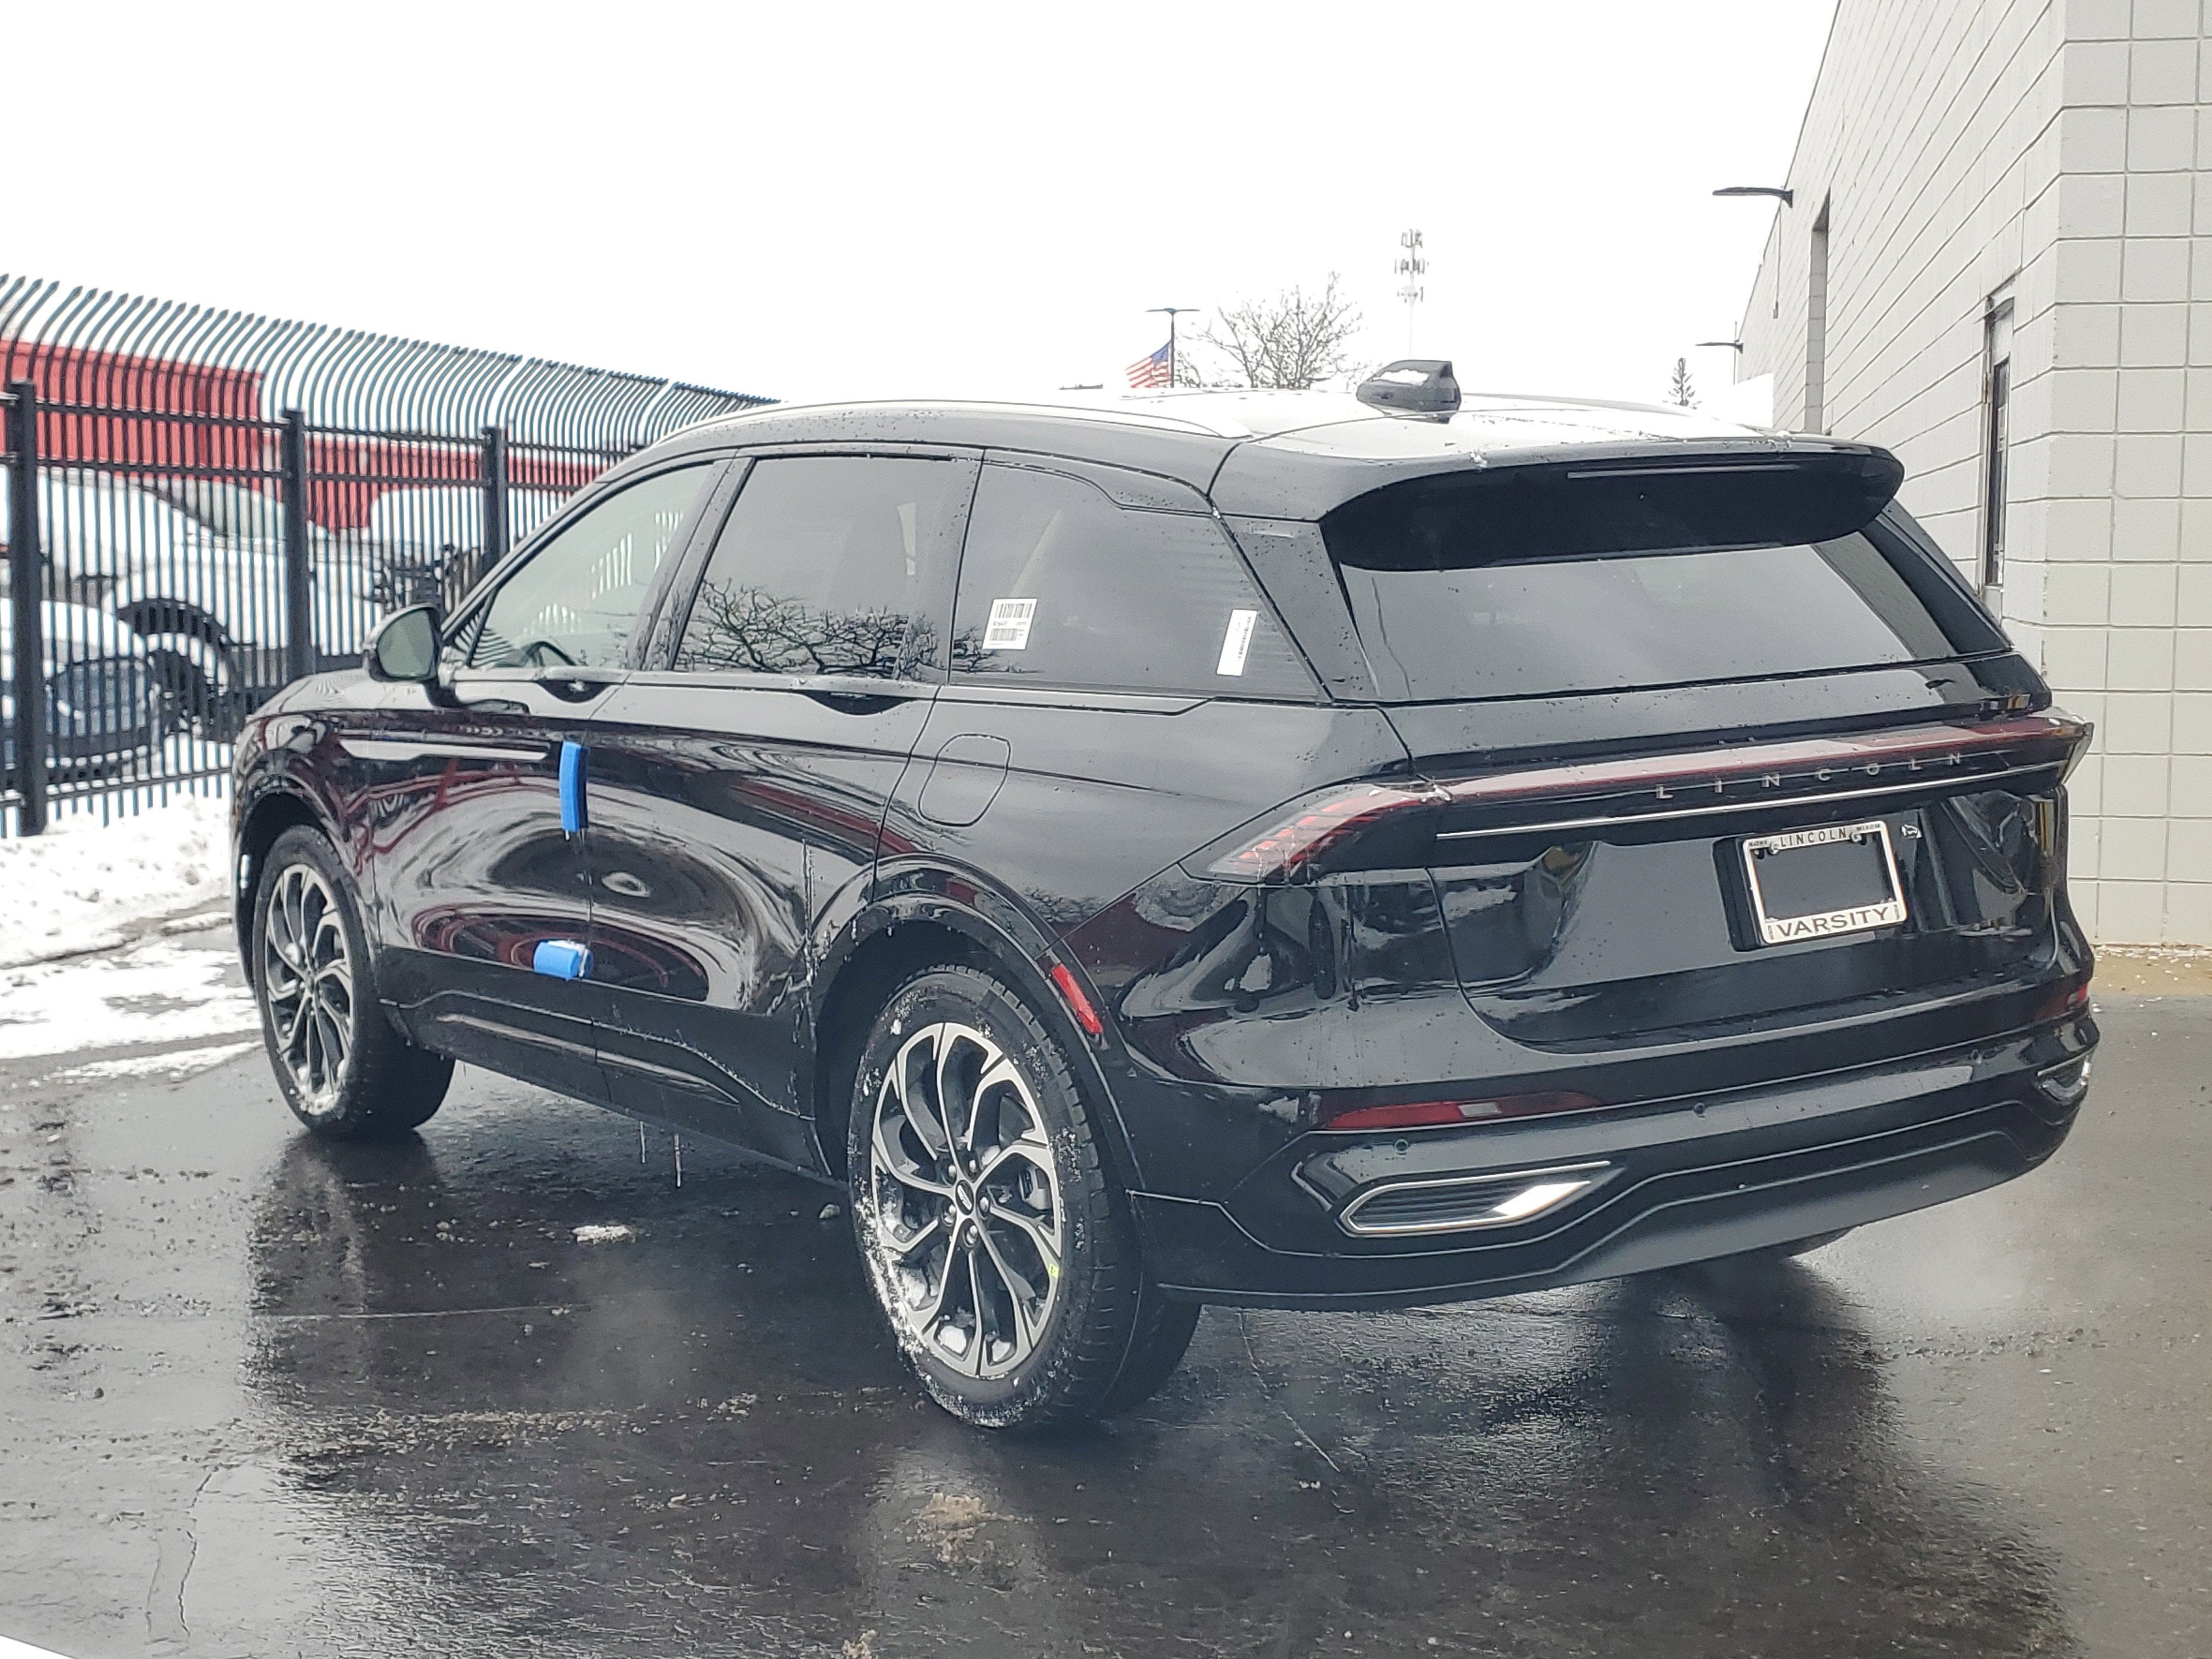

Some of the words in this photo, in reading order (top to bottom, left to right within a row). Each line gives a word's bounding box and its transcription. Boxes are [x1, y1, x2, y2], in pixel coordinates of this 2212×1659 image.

[1655, 753, 1961, 799] LINCOLN
[1780, 827, 1847, 848] LINCOLN
[1776, 906, 1889, 937] VARSITY
